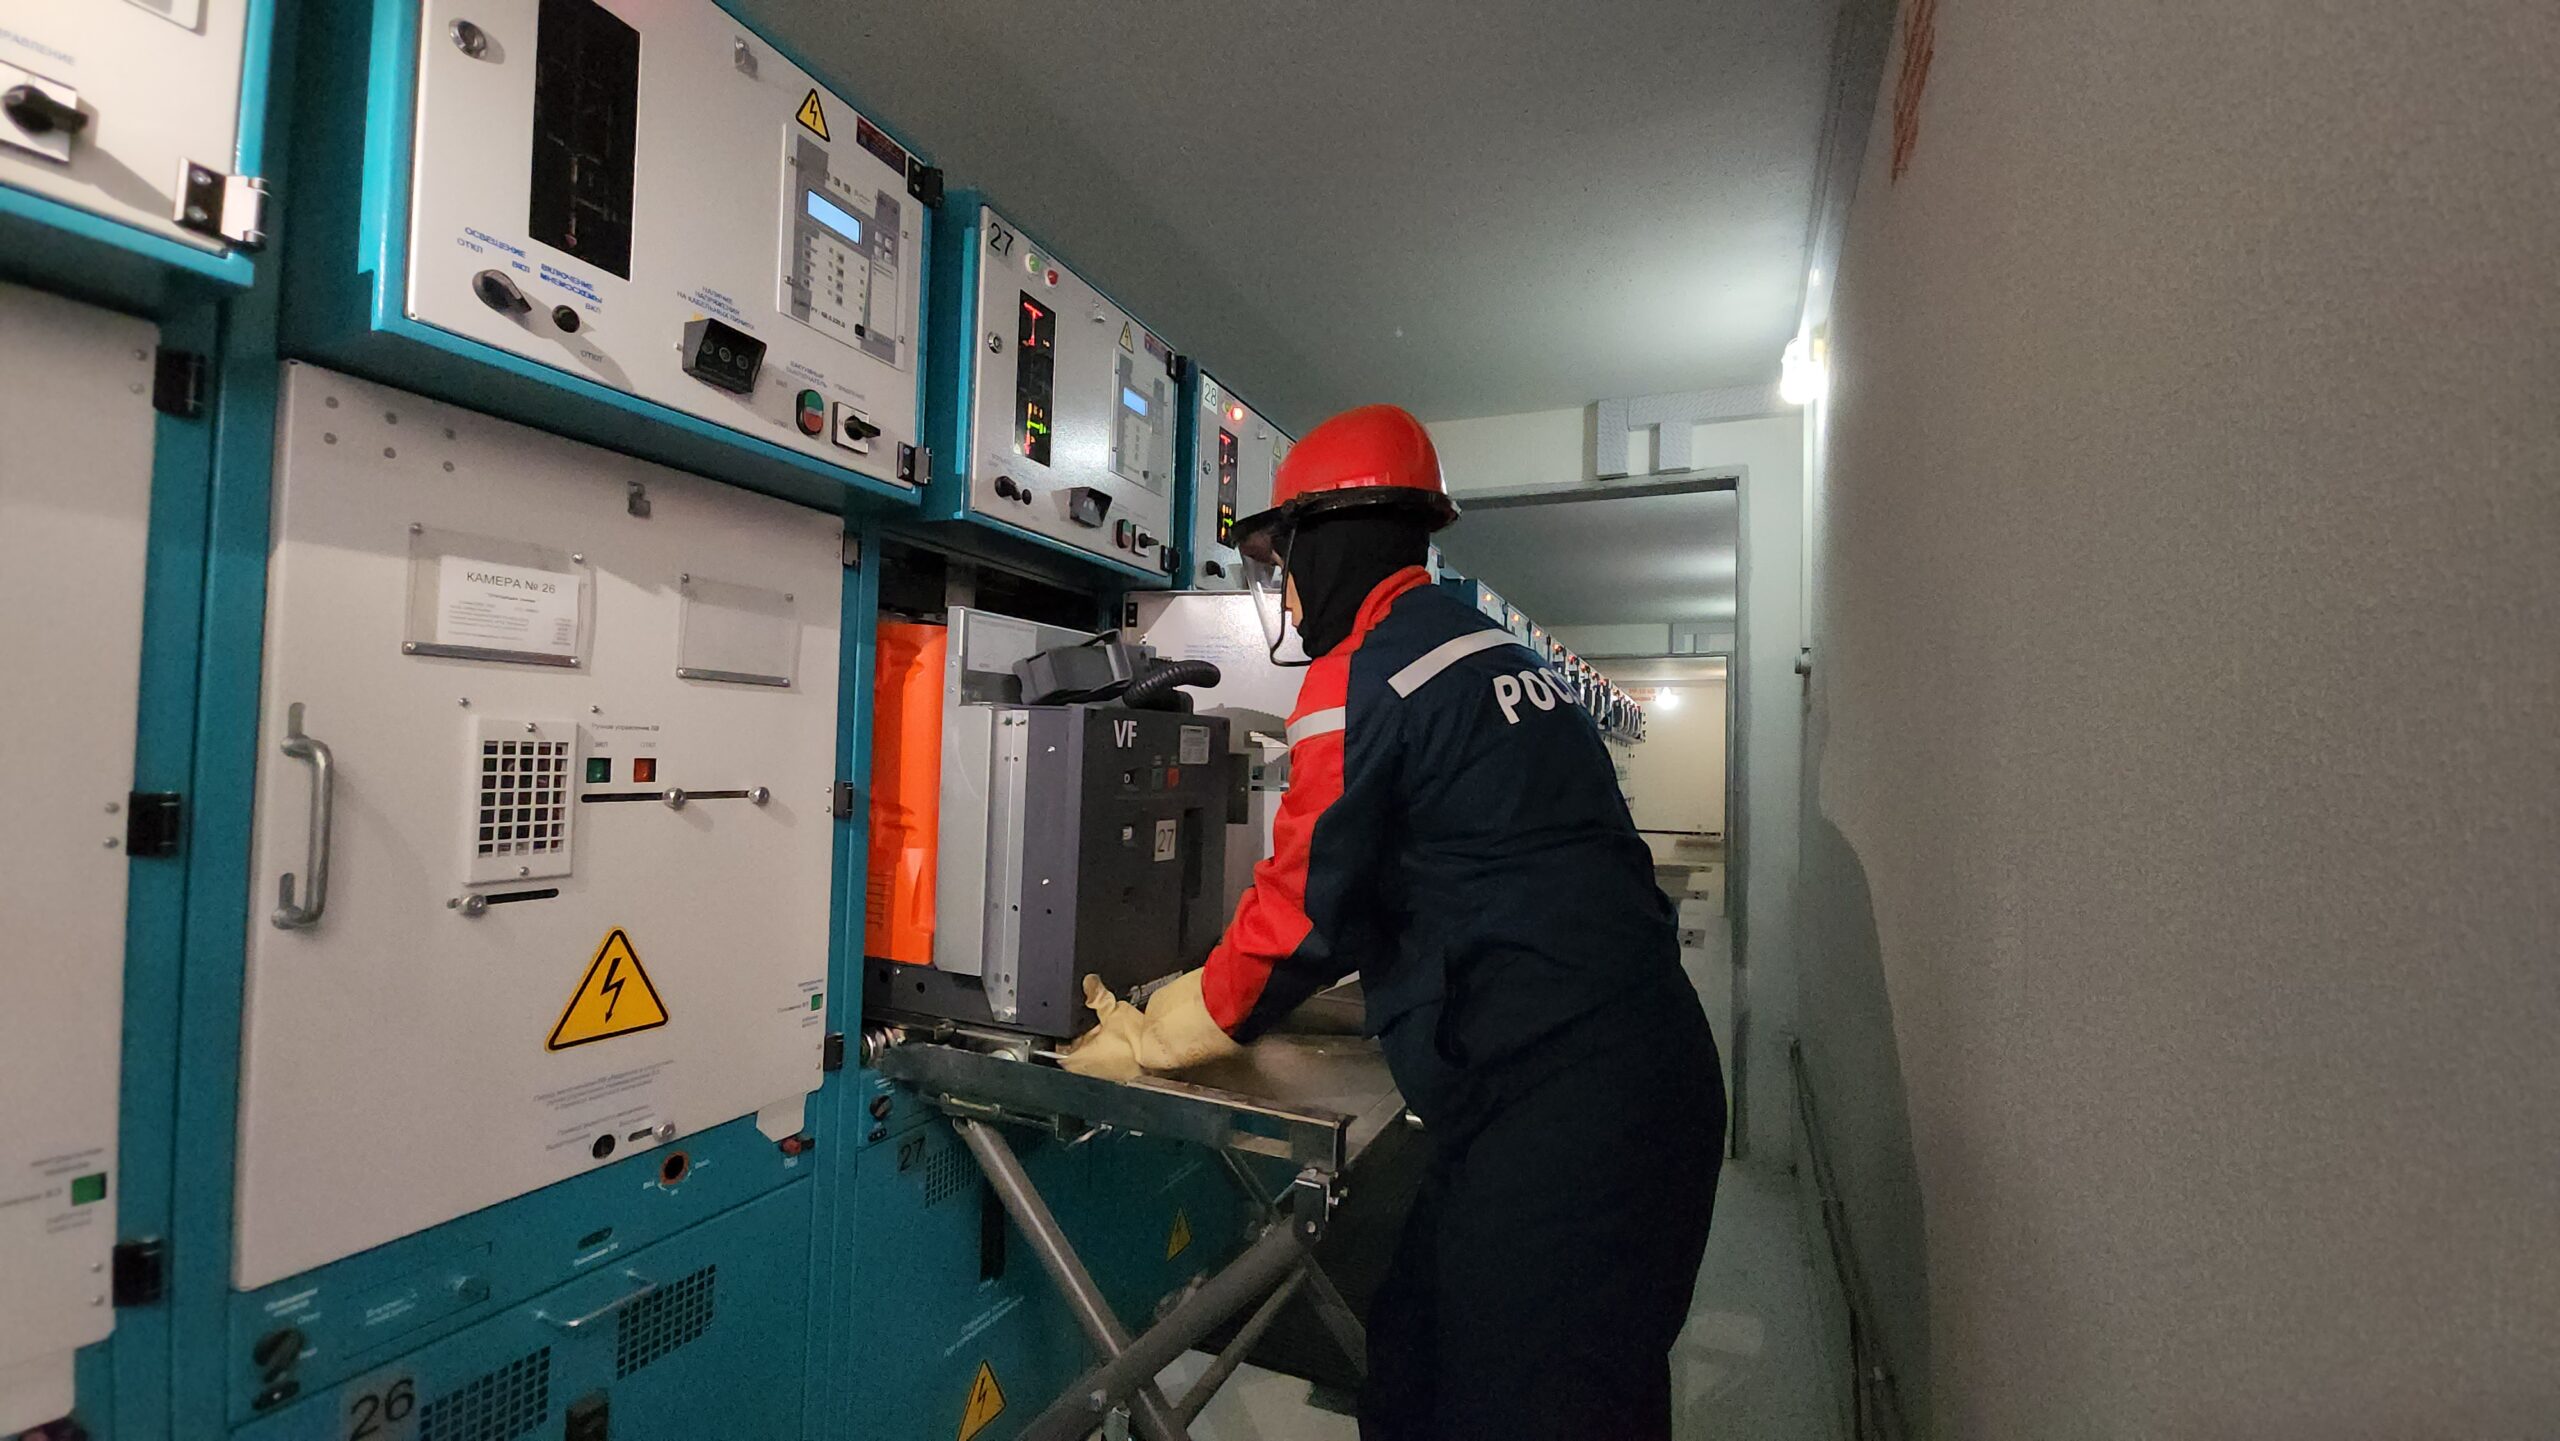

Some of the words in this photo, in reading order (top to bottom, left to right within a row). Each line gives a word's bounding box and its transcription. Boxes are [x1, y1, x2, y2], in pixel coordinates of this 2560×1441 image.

[990, 222, 1014, 257] 27
[1204, 382, 1217, 407] 28
[466, 571, 522, 590] КАМЕРА
[525, 580, 539, 591] №
[542, 583, 556, 594] 26
[1113, 719, 1138, 748] VF
[1156, 828, 1174, 853] 27
[899, 1135, 926, 1172] 27
[349, 1378, 416, 1441] 26
